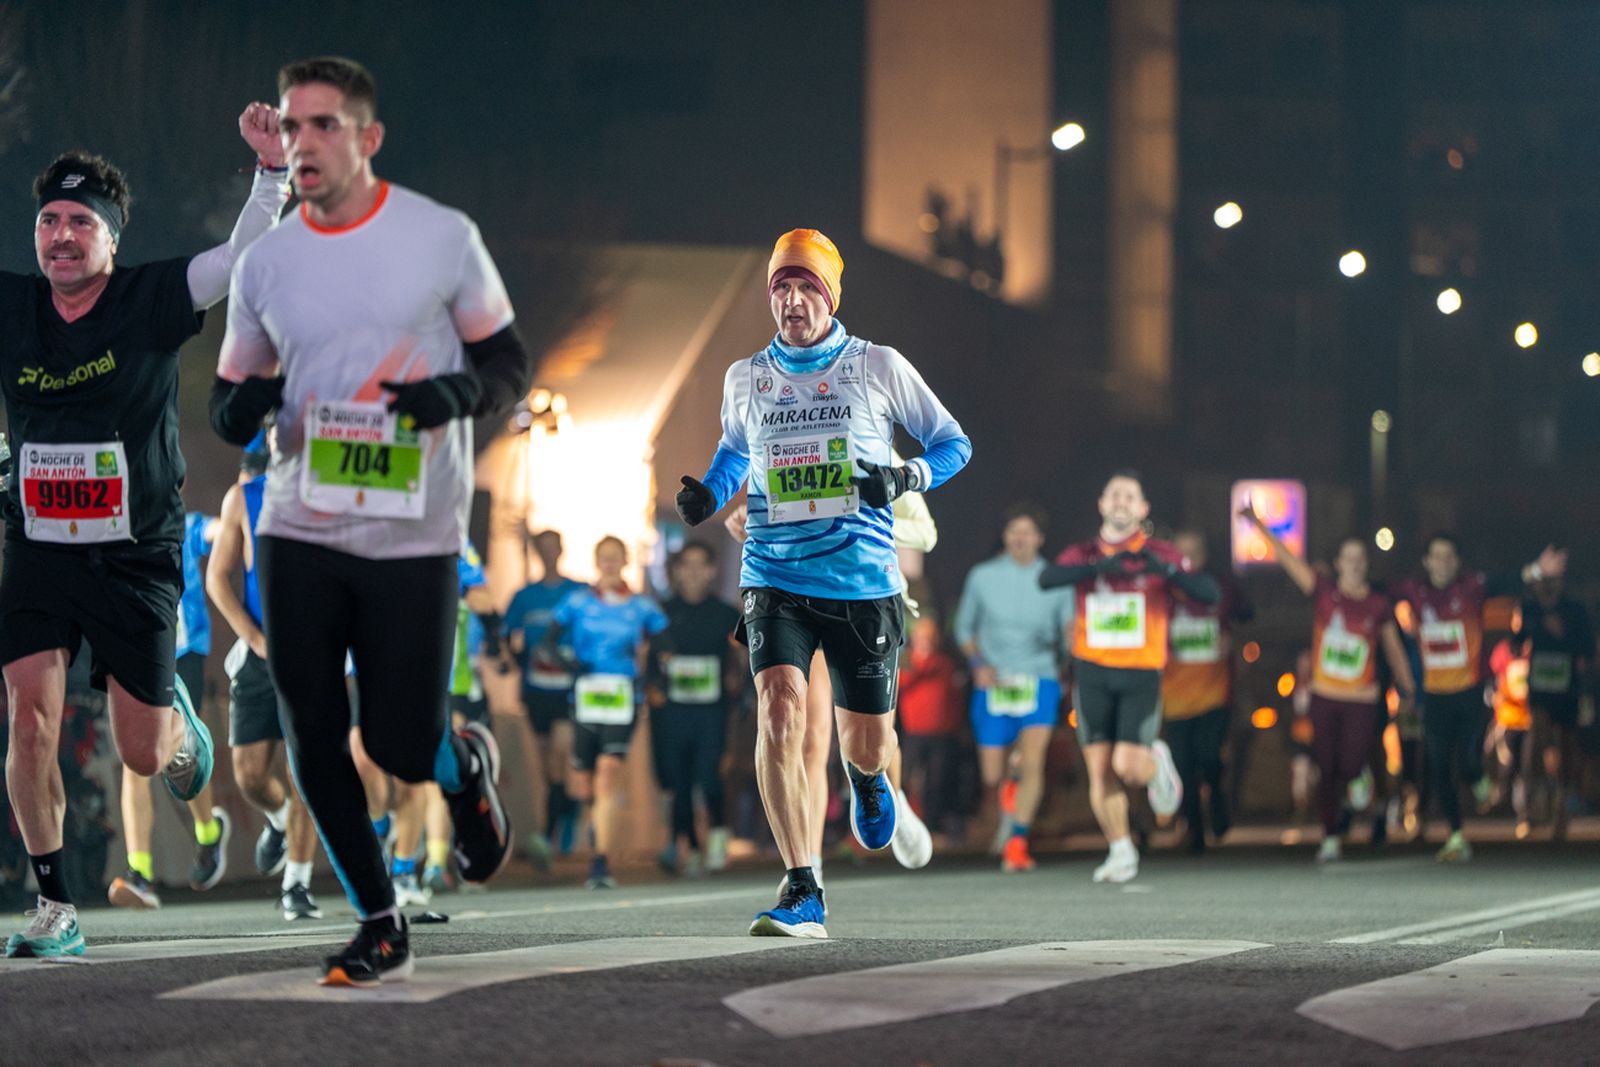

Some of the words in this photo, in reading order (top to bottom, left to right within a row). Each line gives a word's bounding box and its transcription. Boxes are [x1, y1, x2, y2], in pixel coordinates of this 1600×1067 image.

[761, 405, 852, 426] MARACENA
[782, 444, 809, 456] NOCHE
[810, 443, 820, 454] DE
[40, 456, 71, 465] NOCHE
[73, 456, 85, 465] DE
[338, 442, 391, 478] 704
[773, 457, 790, 468] SAN
[791, 454, 821, 466] ANTÓN
[30, 467, 49, 478] SAN
[777, 463, 844, 493] 13472
[38, 480, 109, 509] 9962
